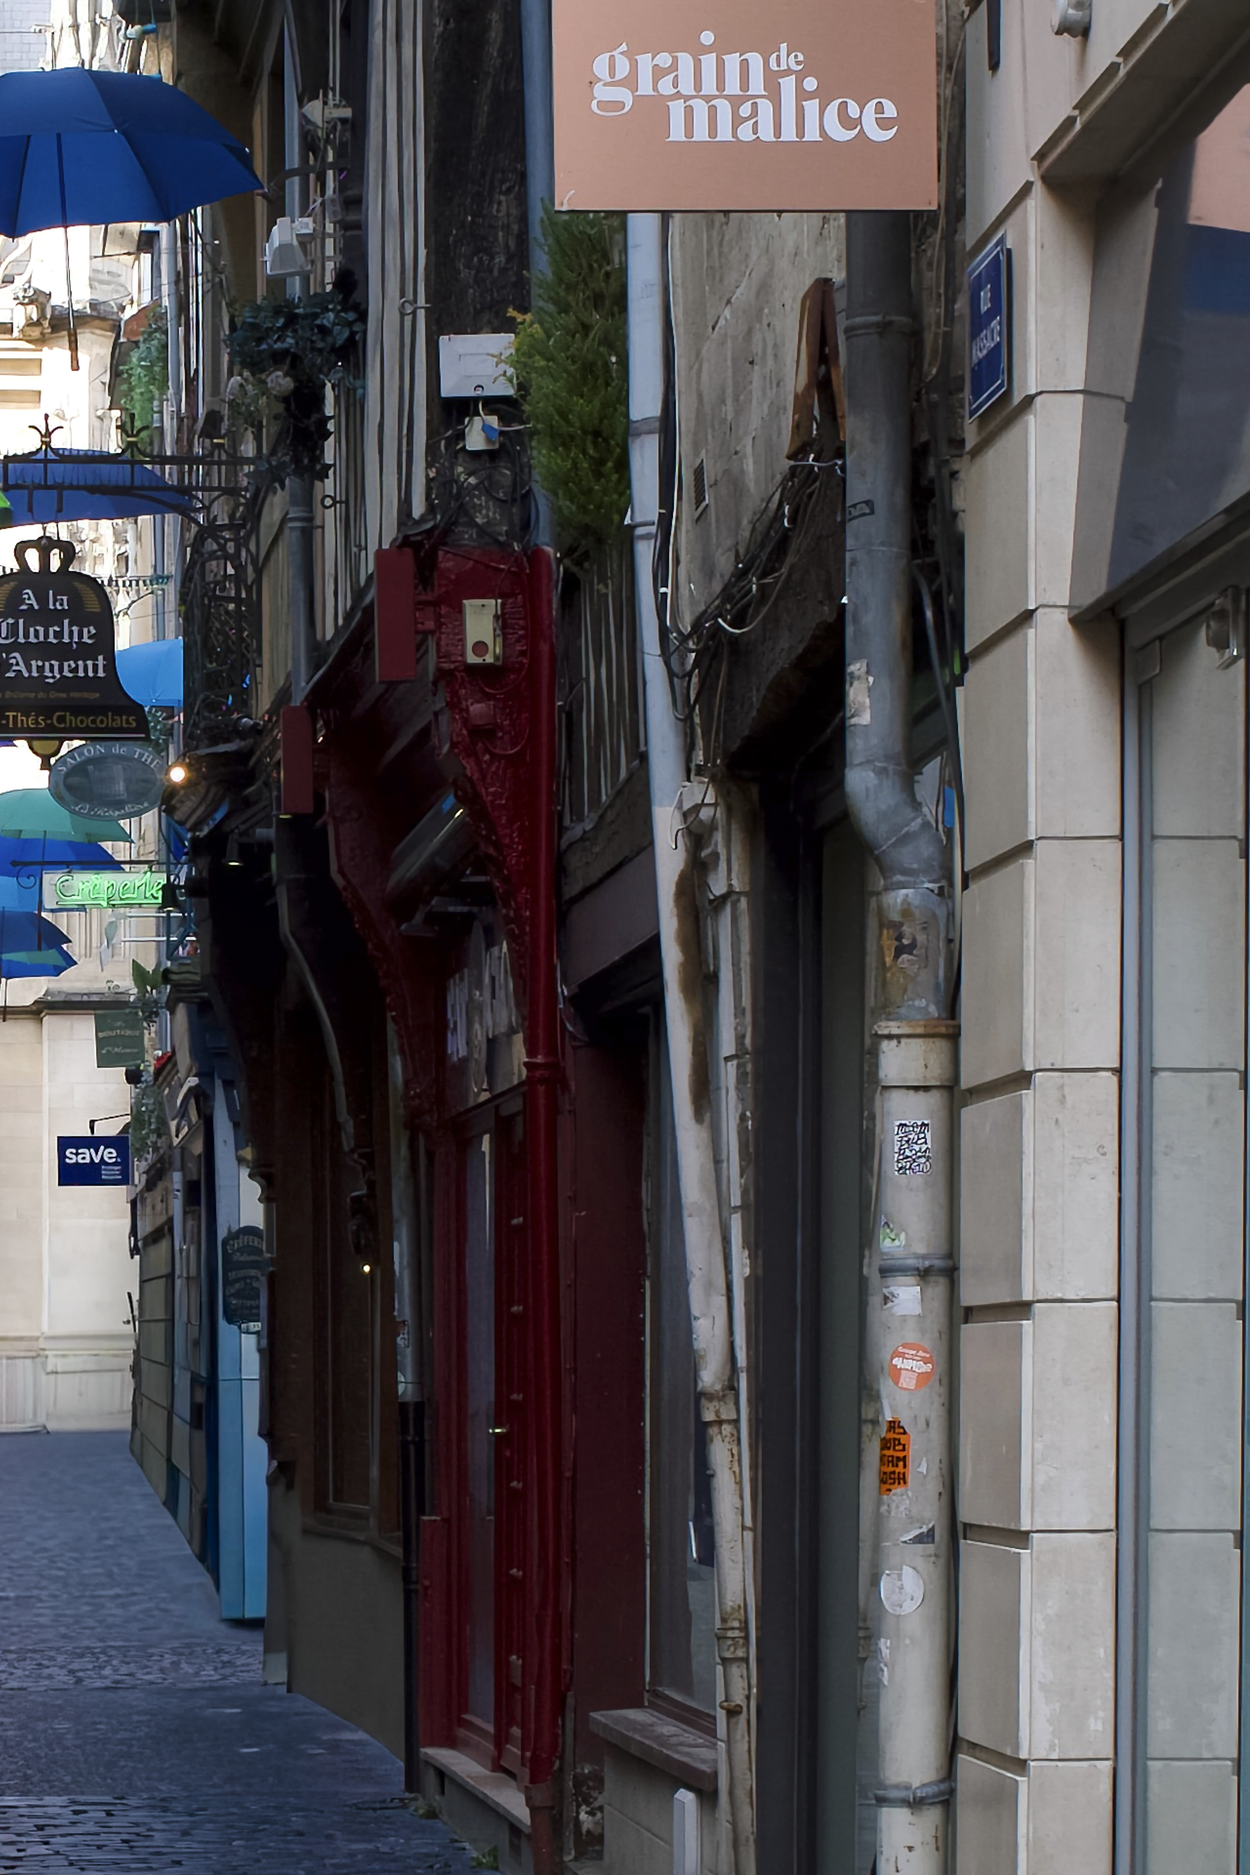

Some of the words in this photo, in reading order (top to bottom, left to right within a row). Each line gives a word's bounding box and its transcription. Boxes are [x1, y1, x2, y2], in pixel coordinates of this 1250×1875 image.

[590, 30, 767, 116] grain
[769, 43, 804, 71] de
[665, 75, 899, 142] malice
[19, 588, 39, 610] A
[49, 589, 69, 610] la
[57, 744, 106, 774] SALON
[111, 743, 127, 755] de
